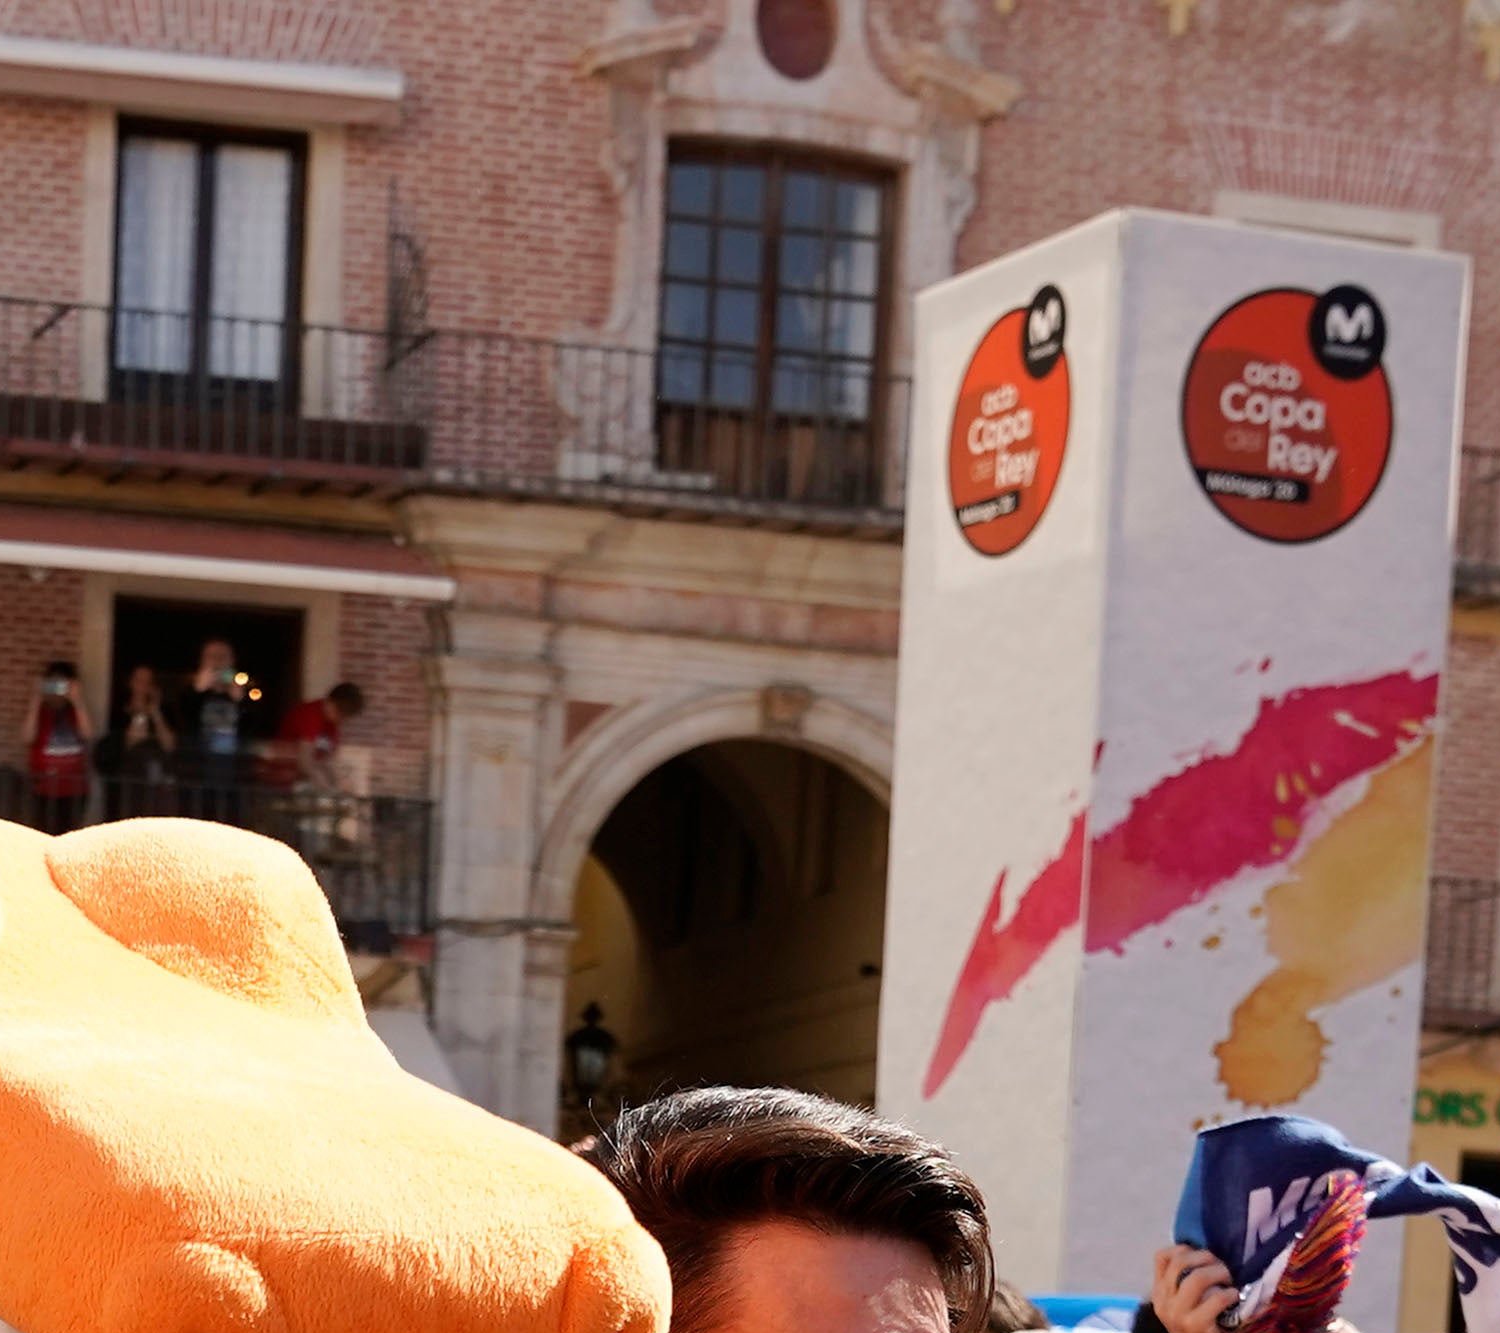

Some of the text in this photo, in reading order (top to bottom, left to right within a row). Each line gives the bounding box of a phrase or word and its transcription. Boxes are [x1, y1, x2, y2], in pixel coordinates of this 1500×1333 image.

[1244, 362, 1301, 391] acb
[1220, 382, 1327, 433] Copa
[968, 409, 1033, 456] Copa
[995, 450, 1040, 489] Rey
[1267, 432, 1338, 484] Rey
